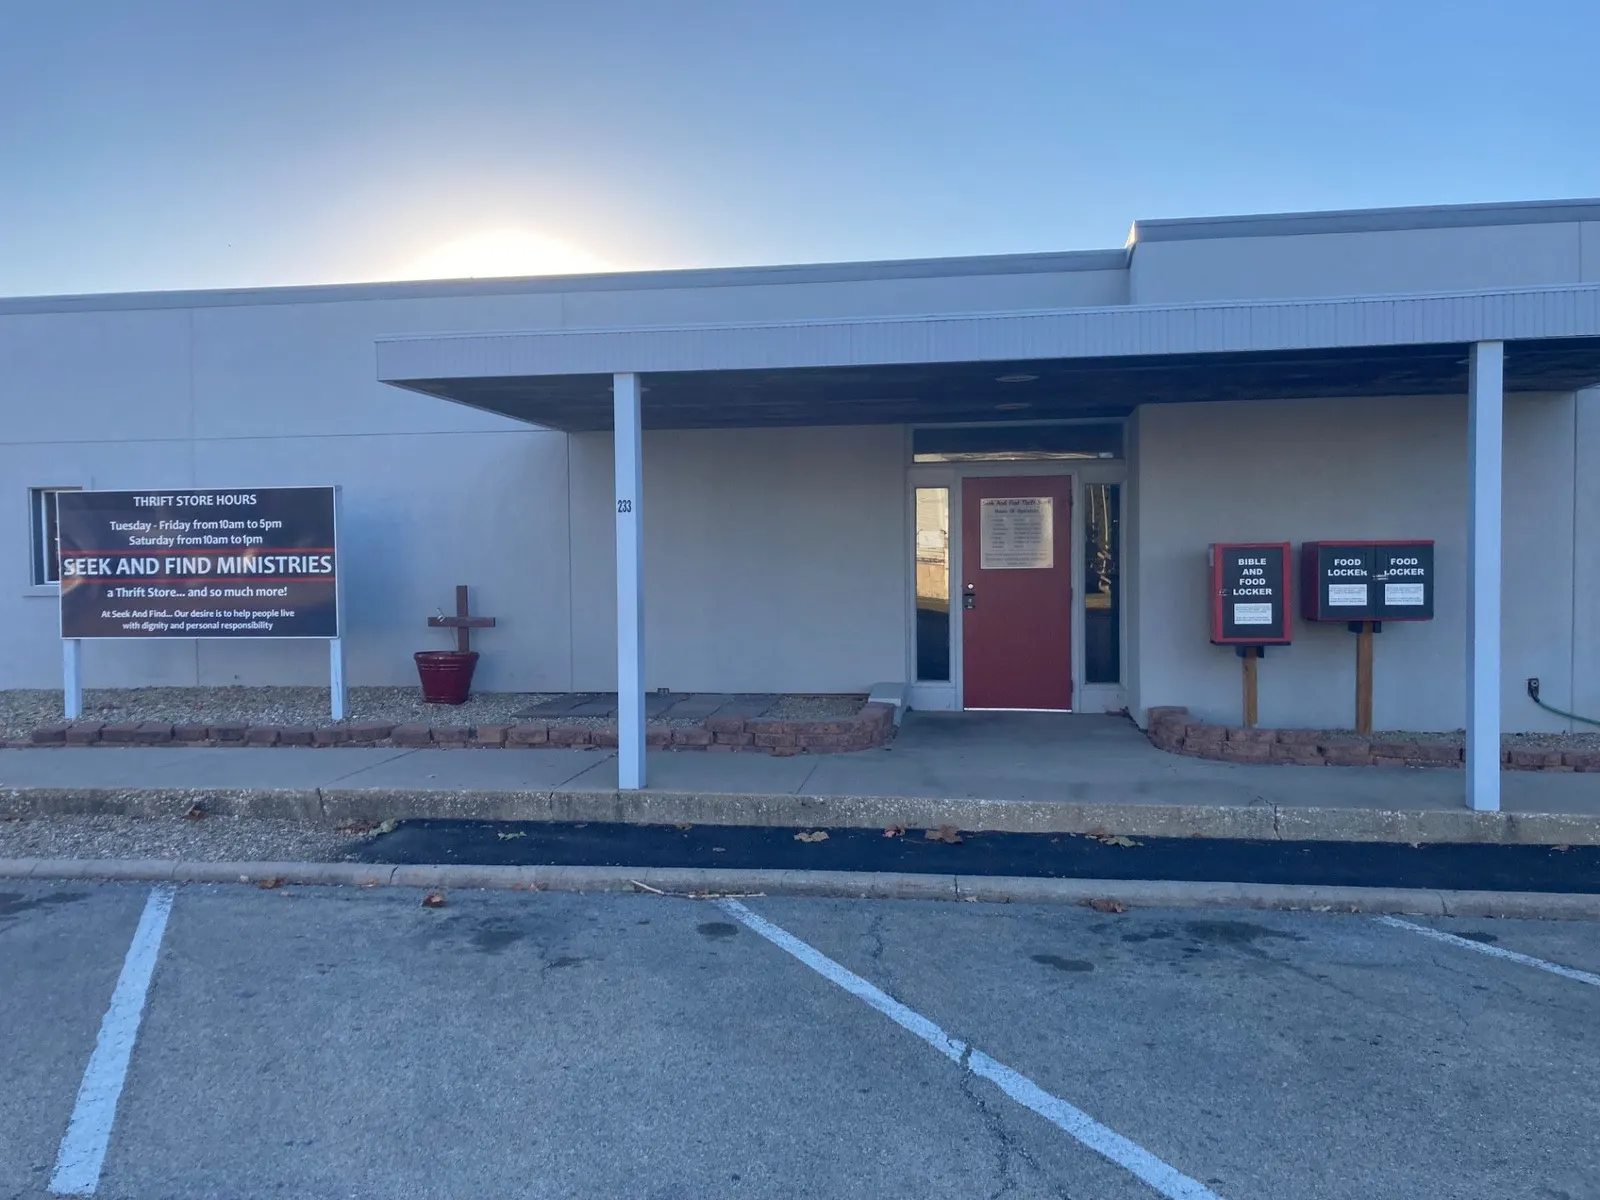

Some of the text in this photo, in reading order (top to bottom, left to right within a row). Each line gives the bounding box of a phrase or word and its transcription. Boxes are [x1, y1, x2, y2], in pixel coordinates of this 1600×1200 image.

[133, 494, 257, 507] THRIFT STORE HOURS
[618, 500, 632, 512] 233
[110, 521, 151, 532] Tuesday
[160, 520, 190, 532] Friday
[193, 520, 218, 529] from
[219, 520, 244, 529] 10am
[247, 520, 258, 528] to
[260, 519, 282, 531] 5pm
[129, 535, 262, 547] Saturday from 10am to 1pm
[64, 556, 332, 576] SEEK AND FIND MINISTRIES
[1238, 558, 1267, 566] BIBLE
[116, 588, 145, 598] Thrift
[147, 588, 186, 598] Store...
[188, 587, 208, 597] and
[210, 589, 222, 597] so
[224, 586, 254, 596] much
[256, 586, 288, 596] more!
[101, 610, 110, 618] At
[112, 610, 130, 618] Seek
[190, 610, 214, 618] desire
[234, 610, 251, 619] help
[252, 610, 280, 619] people
[280, 609, 294, 617] live
[122, 621, 274, 631] with dignity and personal responsibility
